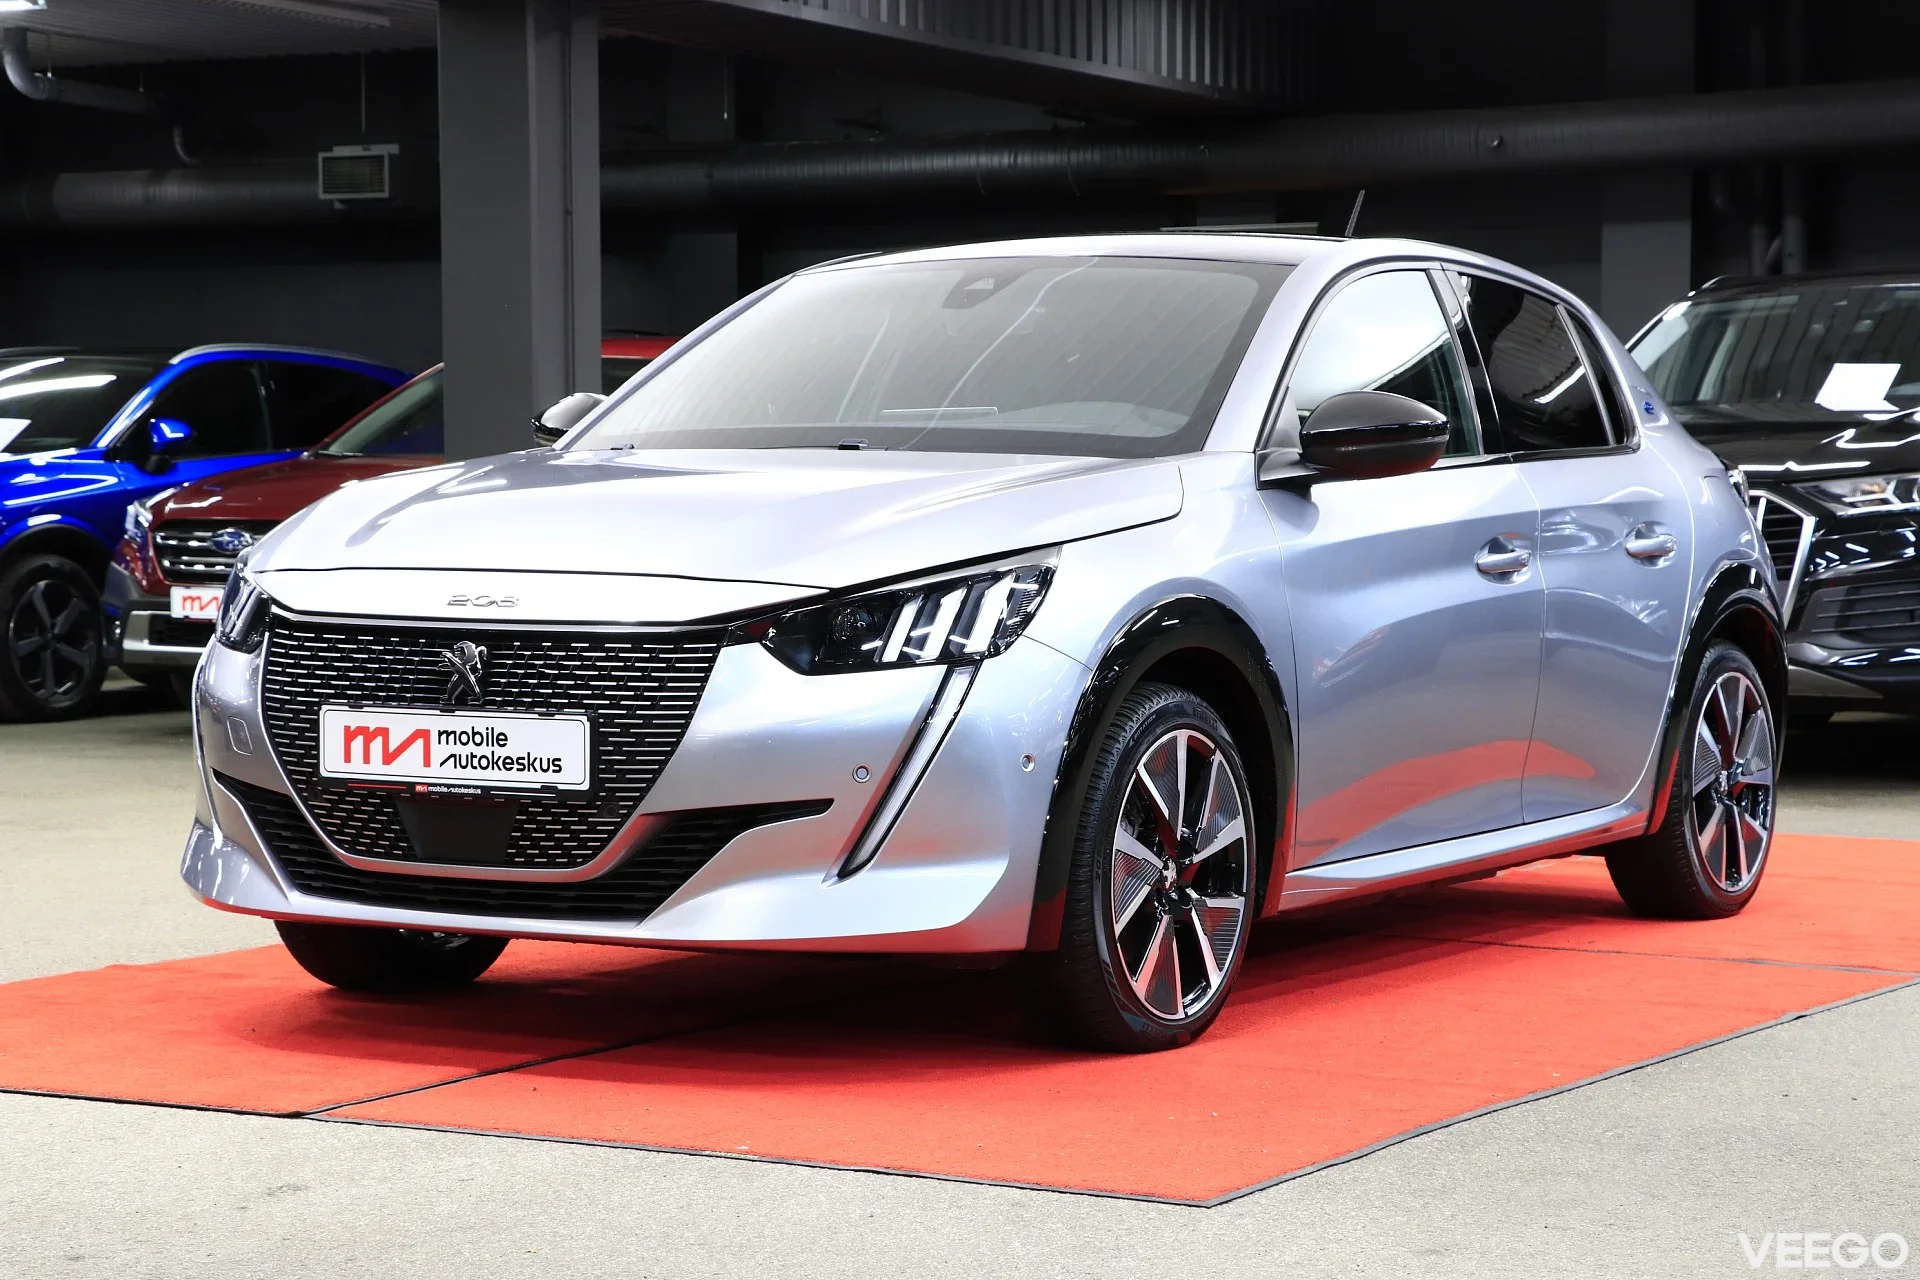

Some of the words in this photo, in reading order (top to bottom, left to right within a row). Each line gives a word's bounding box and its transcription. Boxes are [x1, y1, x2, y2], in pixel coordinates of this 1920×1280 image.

[447, 595, 519, 607] 208
[438, 726, 508, 747] mobile
[440, 751, 562, 774] Autokeskus
